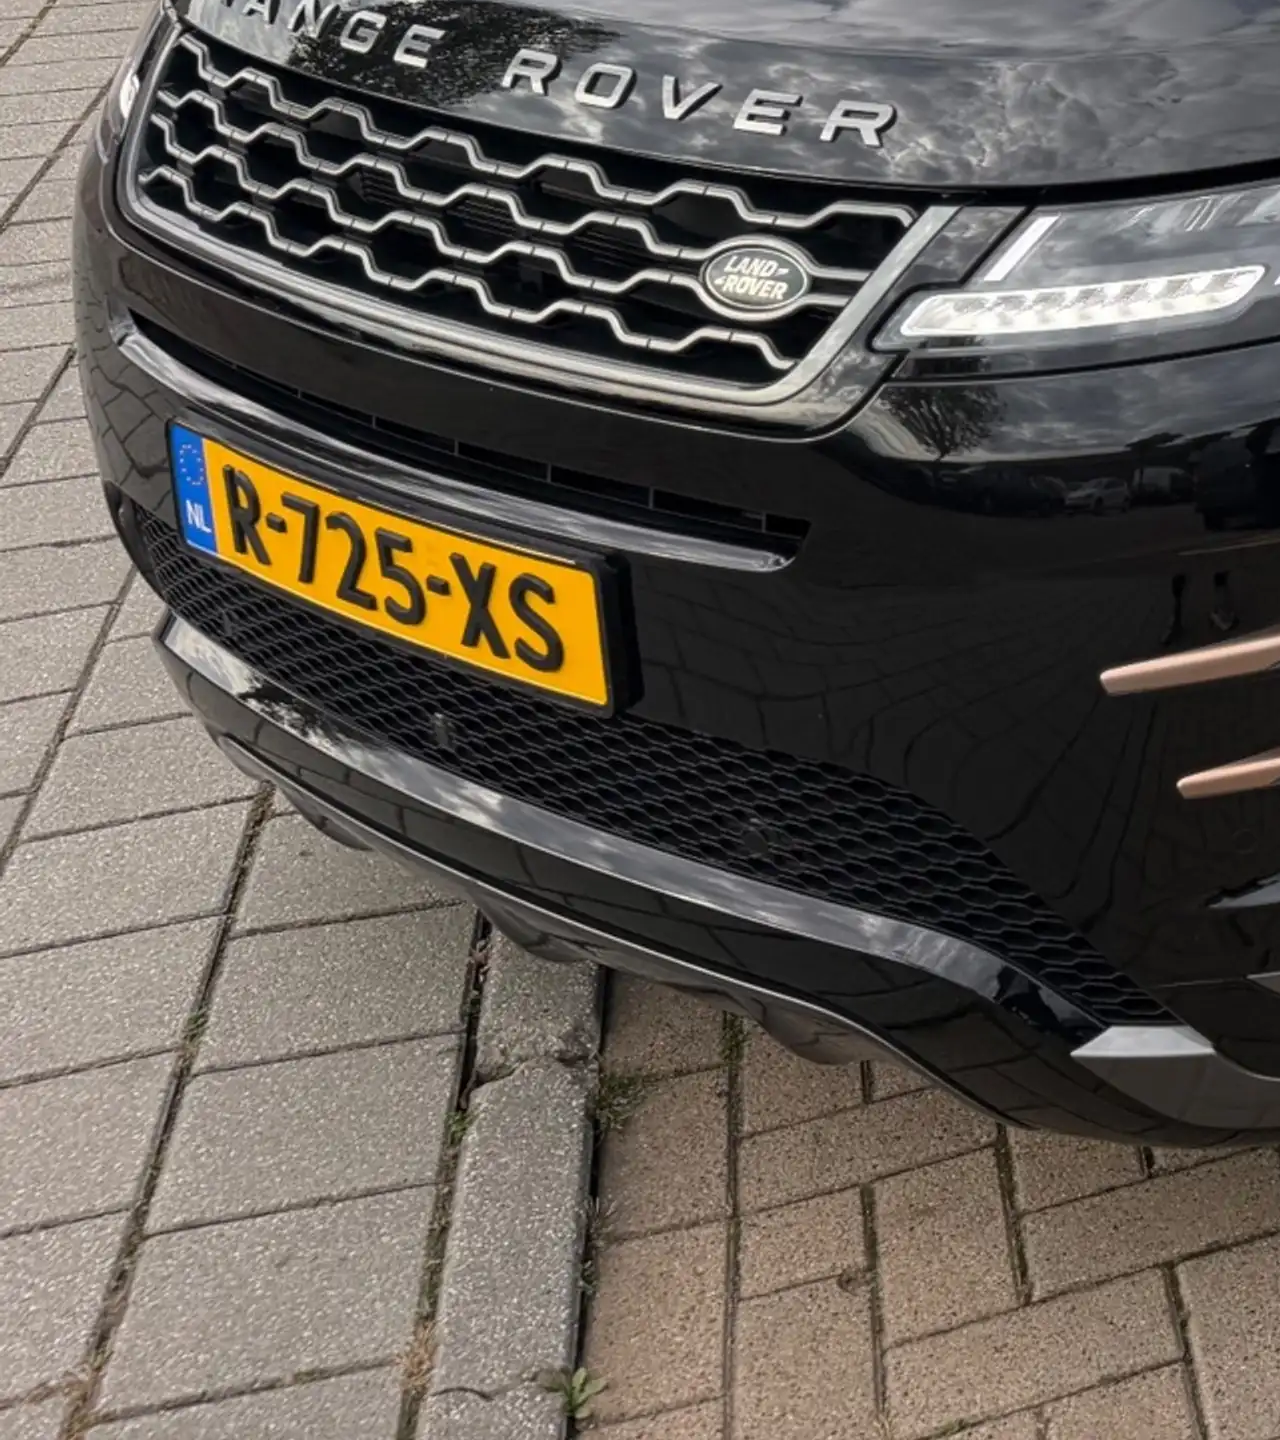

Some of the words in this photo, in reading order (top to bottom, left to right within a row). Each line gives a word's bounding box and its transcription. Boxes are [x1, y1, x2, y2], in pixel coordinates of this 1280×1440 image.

[502, 51, 898, 148] ROVER
[186, 498, 212, 534] NL
[222, 464, 564, 672] R-725-XS
